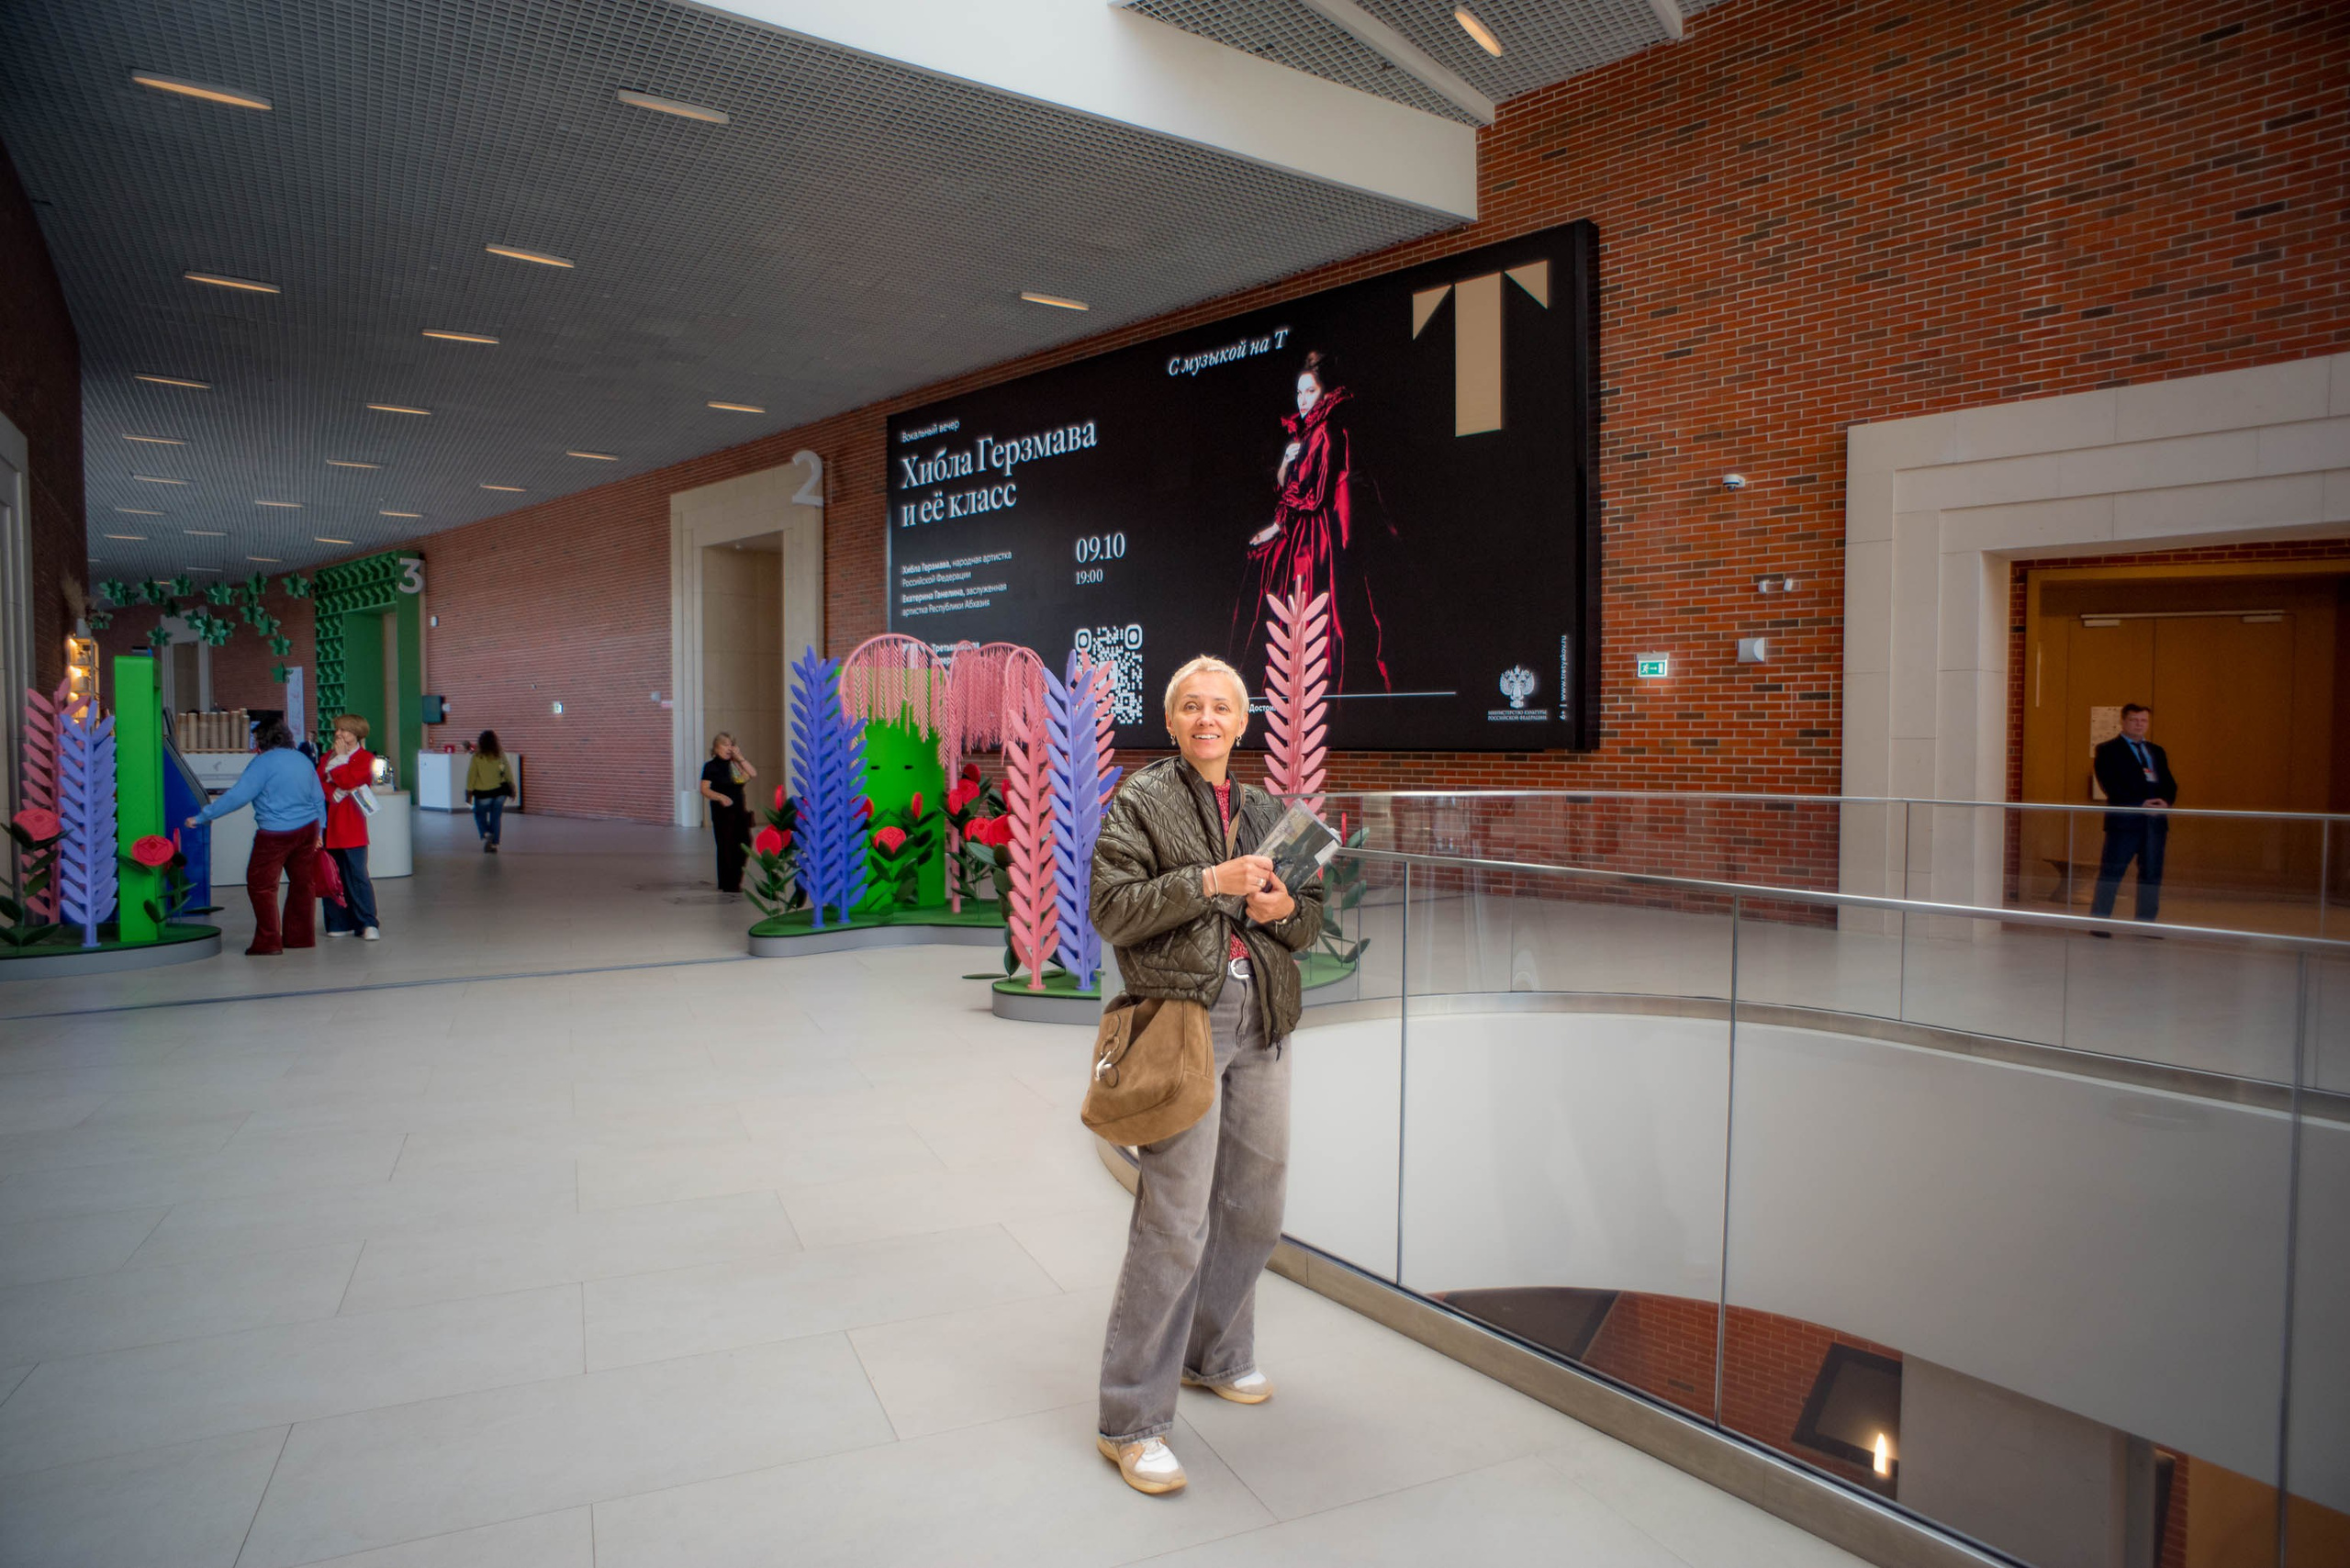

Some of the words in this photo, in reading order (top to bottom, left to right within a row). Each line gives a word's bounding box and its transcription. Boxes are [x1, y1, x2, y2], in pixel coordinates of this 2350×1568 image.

[1169, 356, 1179, 376] С
[1181, 340, 1247, 376] музыкой
[1249, 336, 1270, 355] на
[1274, 329, 1289, 350] Т
[901, 424, 938, 442] Вокальный
[939, 420, 960, 435] вечер
[901, 446, 973, 489] Хибла
[977, 420, 1097, 476] Герзмава
[792, 450, 823, 507] 2
[901, 504, 916, 528] и
[921, 491, 945, 523] её
[949, 483, 1017, 519] класс
[1076, 532, 1125, 564] 09.10
[398, 557, 422, 594] 3
[902, 564, 922, 575] Хибла
[953, 555, 982, 568] народная
[983, 551, 1013, 565] артистка
[1075, 568, 1103, 586] 19:00
[902, 575, 935, 588] Российской
[937, 571, 972, 584] Федерации
[902, 592, 934, 604] Екатерина
[967, 583, 1008, 597] заслуженная
[902, 607, 928, 618] артистка
